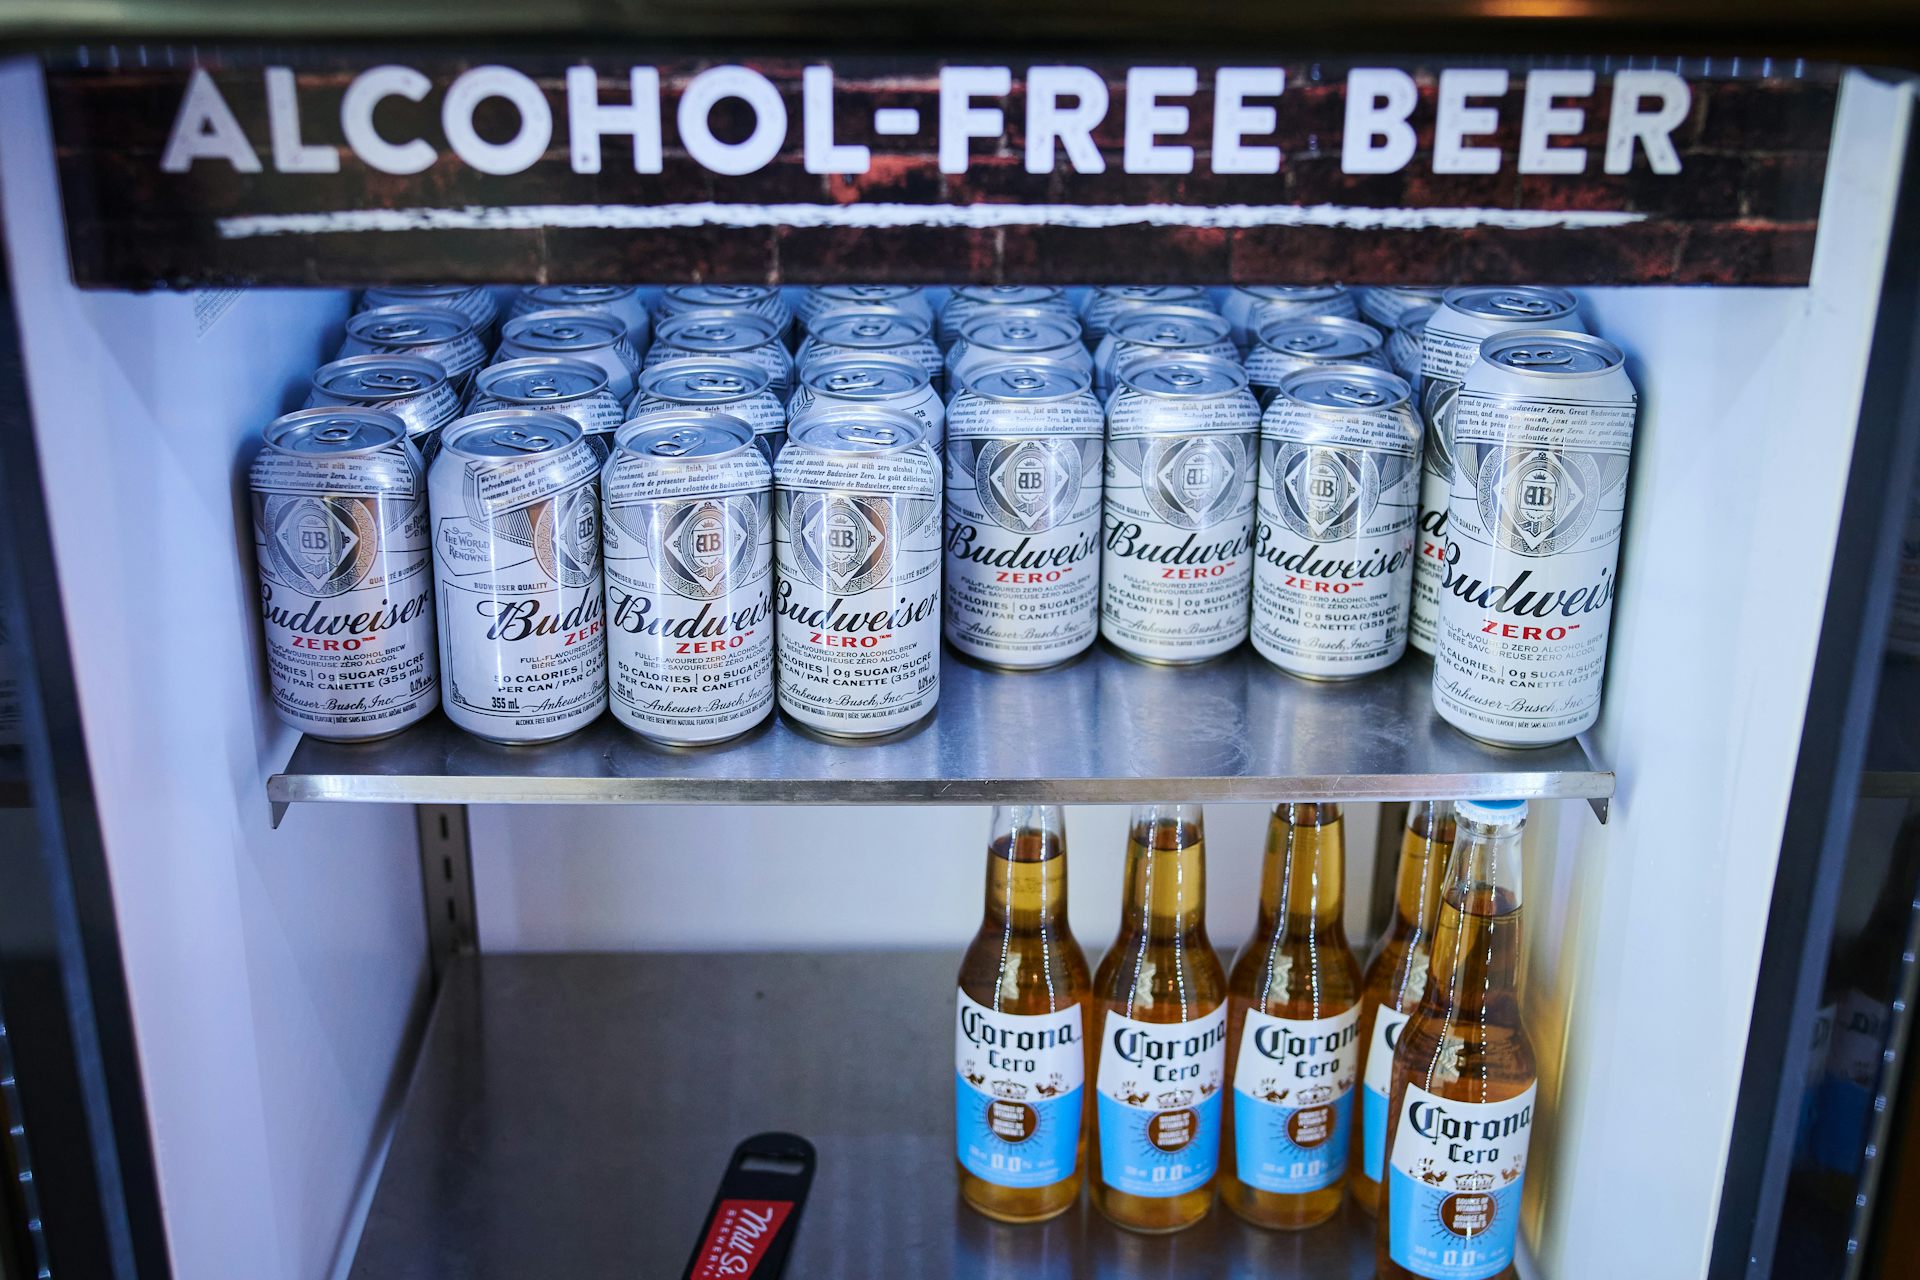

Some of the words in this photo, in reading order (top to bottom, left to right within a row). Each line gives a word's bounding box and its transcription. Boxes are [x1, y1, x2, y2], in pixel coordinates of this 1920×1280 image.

[161, 64, 1285, 176] ALCOHOL-FREE
[1341, 67, 1691, 175] BEER
[1547, 406, 1566, 415] Zero.
[1569, 408, 1588, 416] Great
[826, 469, 858, 479] Budweiser
[860, 471, 875, 479] Zero.
[893, 465, 913, 473] alcohol
[856, 481, 891, 490] Budweiser,
[449, 545, 492, 562] RENOWNE
[474, 582, 516, 591] BUDWEISER
[518, 582, 547, 591] QUALITY
[958, 591, 1009, 610] CALORIES
[1120, 589, 1174, 606] CALORIES
[966, 603, 983, 615] CAN
[992, 612, 1015, 620] PAR
[1018, 610, 1067, 620] CANETTE
[1127, 601, 1147, 612] CAN
[1156, 608, 1179, 616] PAR
[1183, 604, 1228, 616] CANETTE
[1279, 615, 1299, 626] PAR
[1303, 621, 1356, 631] CANETTE
[1447, 631, 1466, 646] BIÈRE
[1511, 644, 1539, 652] ZERO
[1542, 641, 1586, 652] ALCOHOL
[343, 652, 383, 661] ALCOHOL
[385, 644, 406, 655] BREW
[520, 644, 587, 663] FULL-FLAVOURED
[728, 645, 758, 658] ALCOHOL
[803, 652, 855, 664] SAVOUREUSE
[880, 652, 910, 663] ALCOOL
[860, 649, 898, 657] ALCOHOL
[899, 642, 918, 653] BREW
[339, 652, 425, 680] SUGAR/SUCRE
[341, 660, 362, 668] ZÉRO
[365, 655, 397, 665] ALCOOL
[531, 661, 556, 670] BIÈRE
[668, 662, 723, 671] SAVOUREUSE
[725, 657, 744, 666] ZÉRO
[855, 651, 932, 676] SUGAR/SUCRE
[1447, 647, 1497, 673] CALORIES
[516, 666, 578, 683] CALORIES
[618, 661, 629, 671] 50
[632, 668, 691, 682] CALORIES
[784, 663, 800, 676] CAN
[807, 675, 829, 684] PAR
[833, 679, 887, 687] CANETTE
[1454, 662, 1472, 676] CAN
[1481, 674, 1505, 685] PAR
[1509, 680, 1564, 688] CANETTE
[293, 679, 318, 689] PAR
[318, 681, 375, 690] CANETTE
[528, 683, 553, 692] CAN
[563, 675, 583, 686] PAR
[620, 673, 637, 686] PER
[641, 682, 662, 692] CAN
[702, 676, 751, 692] CANETTE
[491, 696, 506, 709] 355
[508, 698, 519, 709] mL
[962, 1005, 1073, 1050] Corona
[1113, 1019, 1226, 1069] Corona
[988, 1049, 1035, 1073] Cero
[1294, 1055, 1340, 1079] Cero
[1153, 1063, 1200, 1082] Cero
[1408, 1100, 1531, 1145] Corona
[1448, 1143, 1499, 1164] Cero
[728, 1207, 773, 1254] Mill
